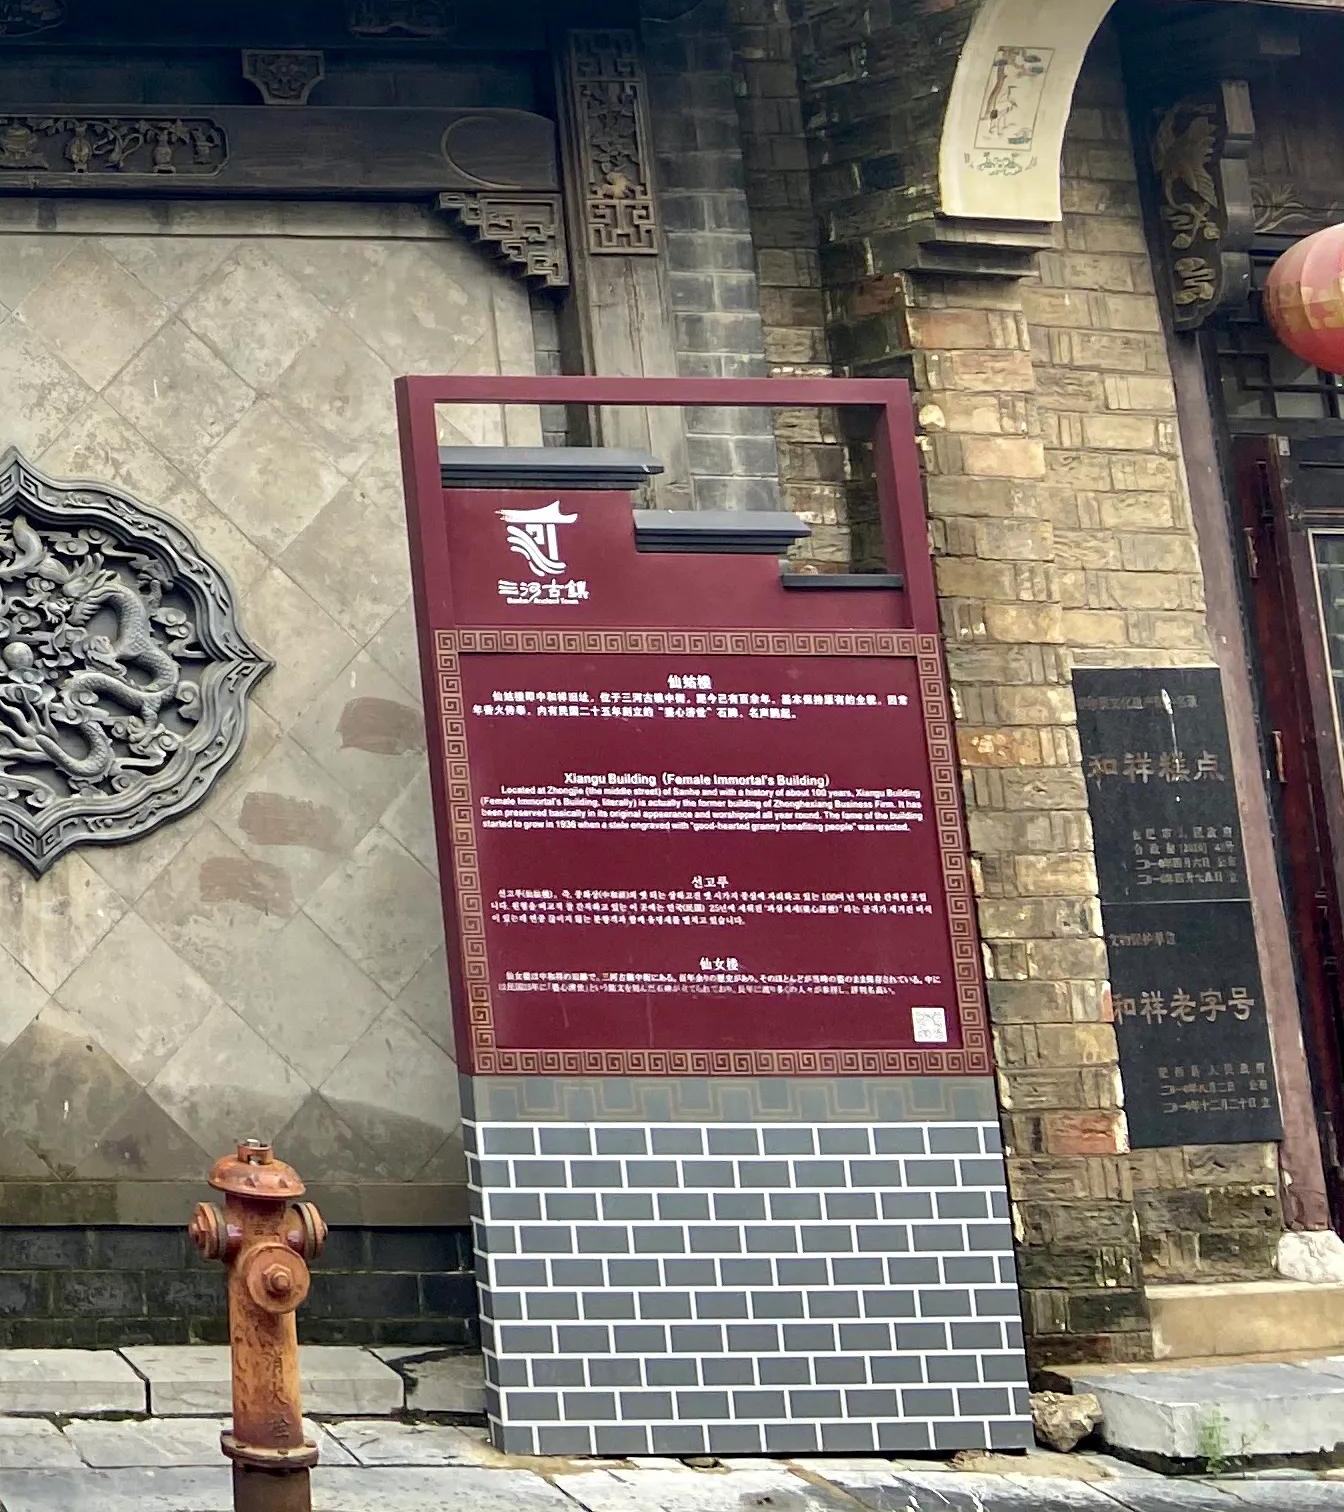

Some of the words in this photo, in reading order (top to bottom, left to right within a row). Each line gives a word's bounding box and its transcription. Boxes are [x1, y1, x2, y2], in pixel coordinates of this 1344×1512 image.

[564, 773, 607, 787] Xiangu
[608, 774, 657, 787] Building
[713, 775, 775, 786] Immortal's
[777, 774, 830, 788] Building)
[1112, 987, 1255, 1025] 和祥老字号
